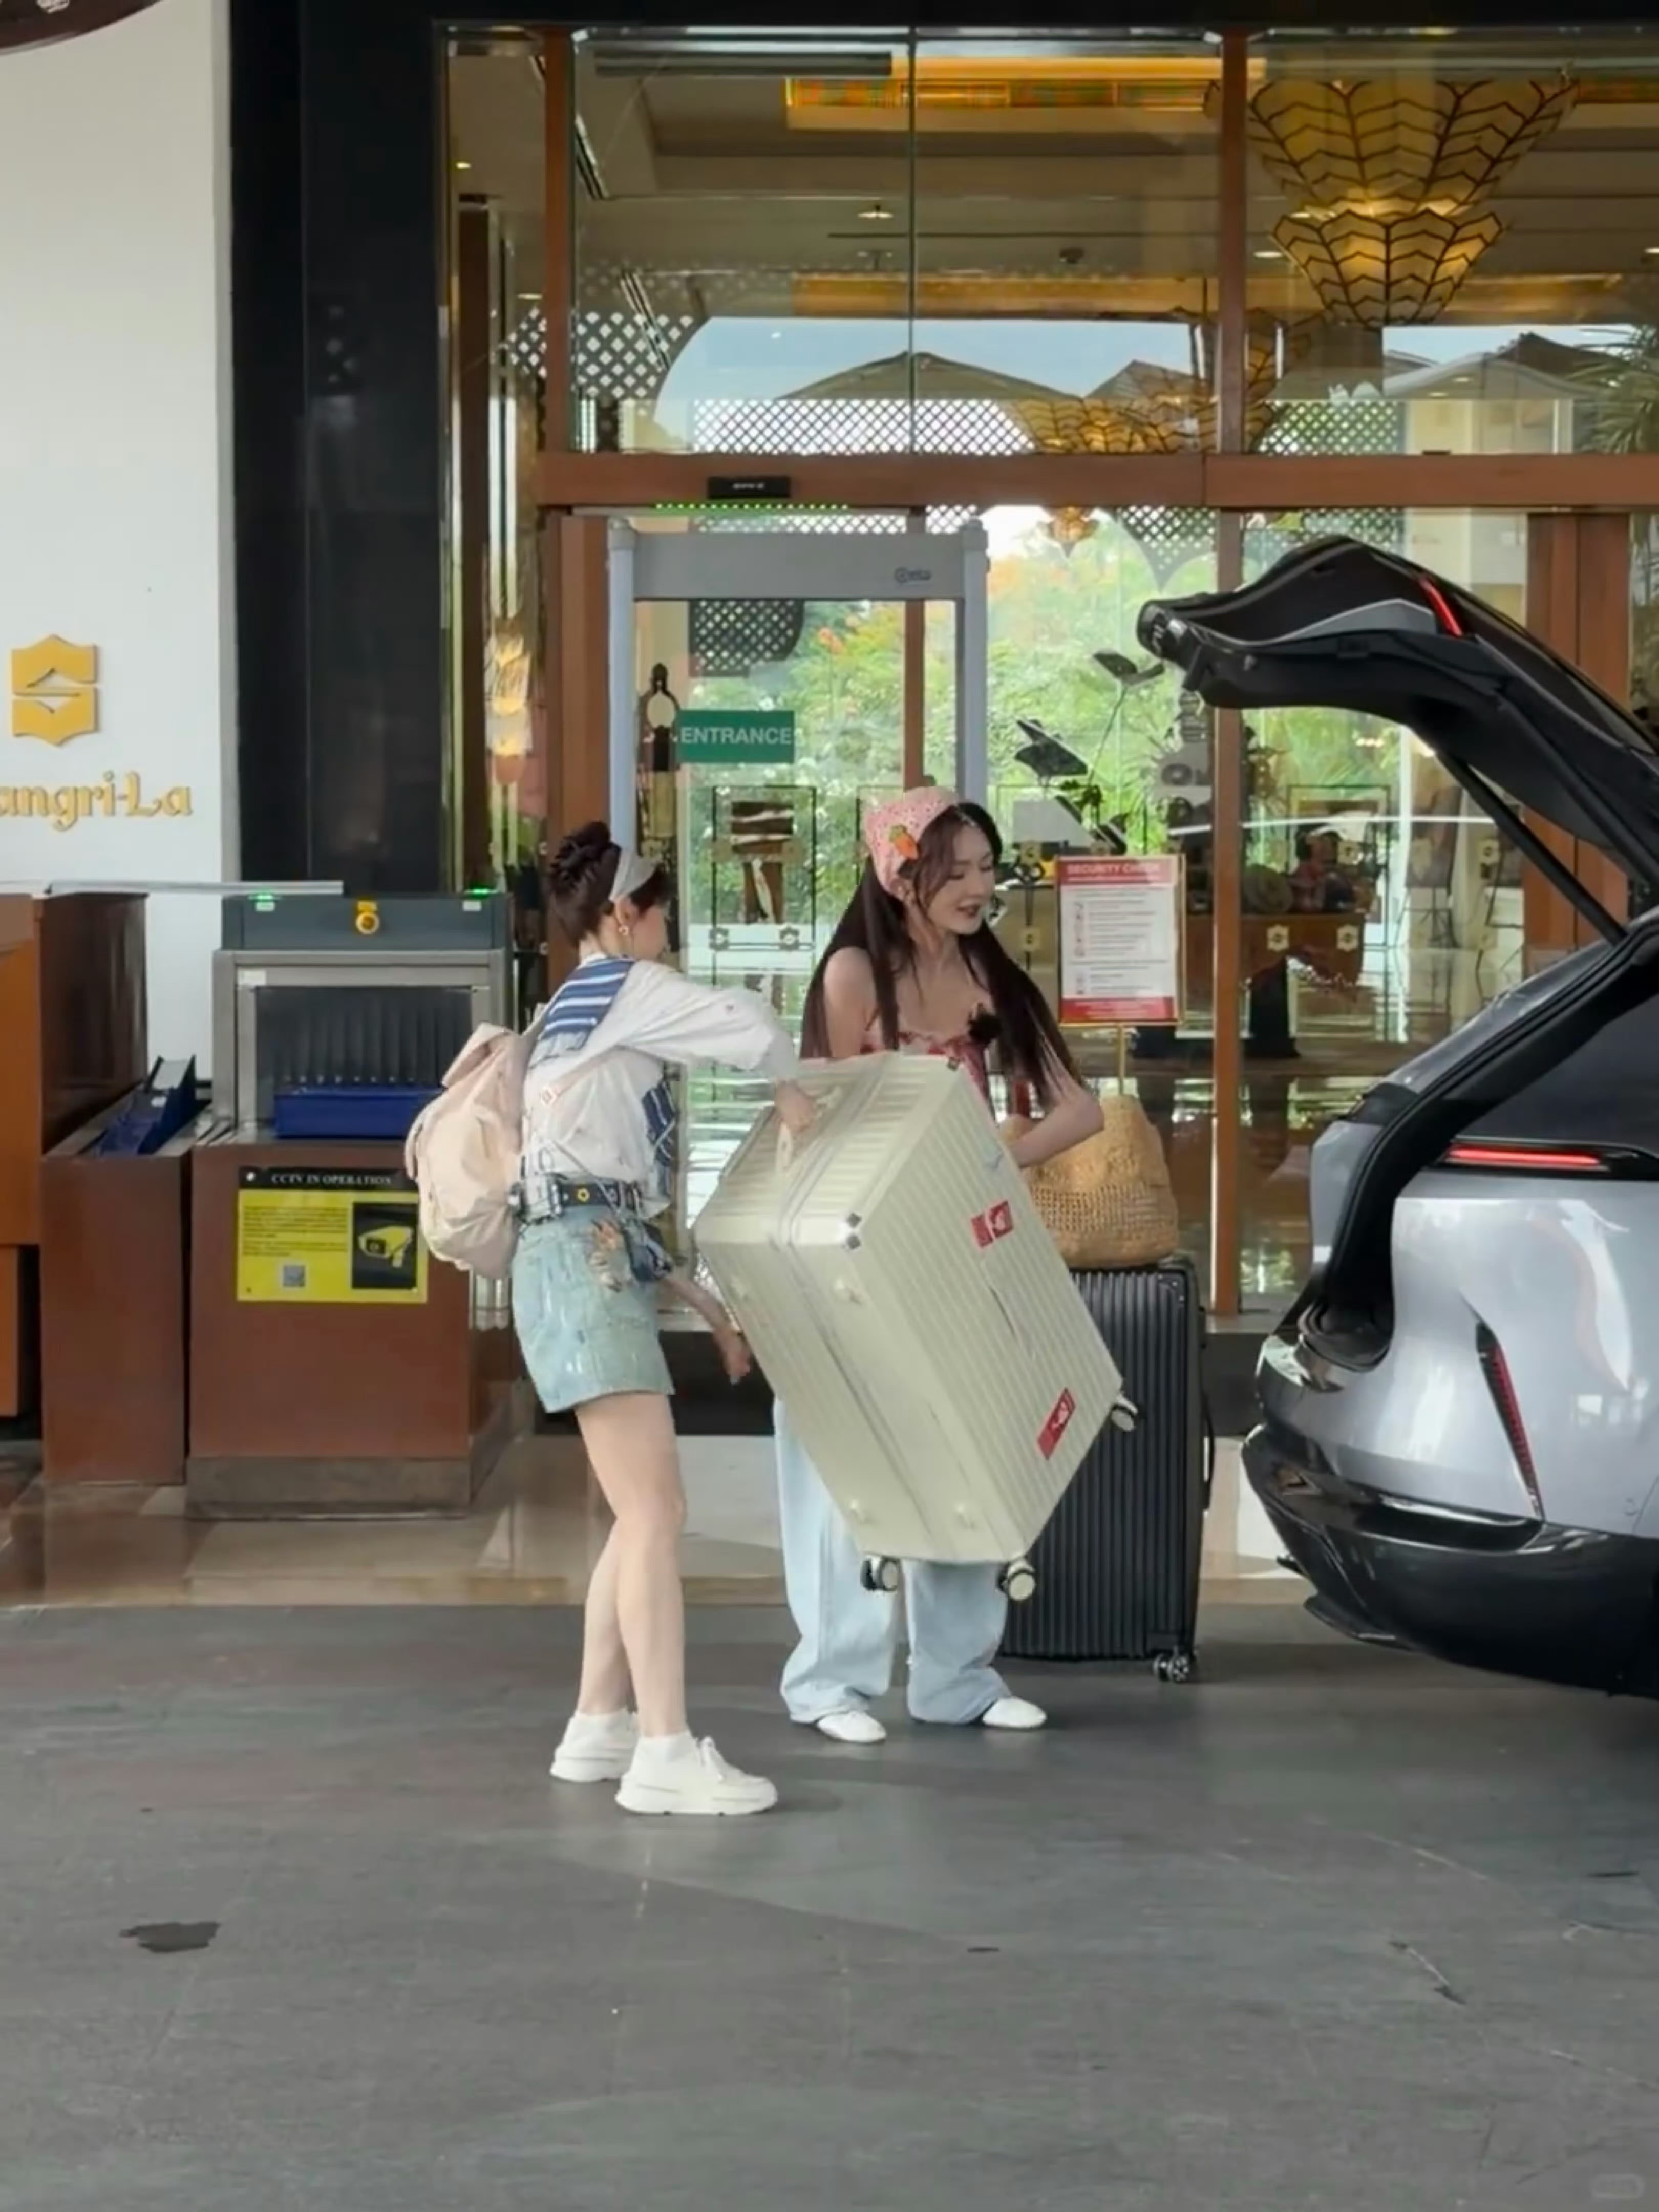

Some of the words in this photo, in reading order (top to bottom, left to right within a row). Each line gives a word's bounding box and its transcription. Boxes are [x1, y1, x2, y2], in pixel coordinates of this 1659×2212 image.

[680, 727, 792, 745] ENTRANCE
[271, 1174, 303, 1184] CCTV
[306, 1174, 320, 1184] IN
[322, 1174, 392, 1185] OPERATION
